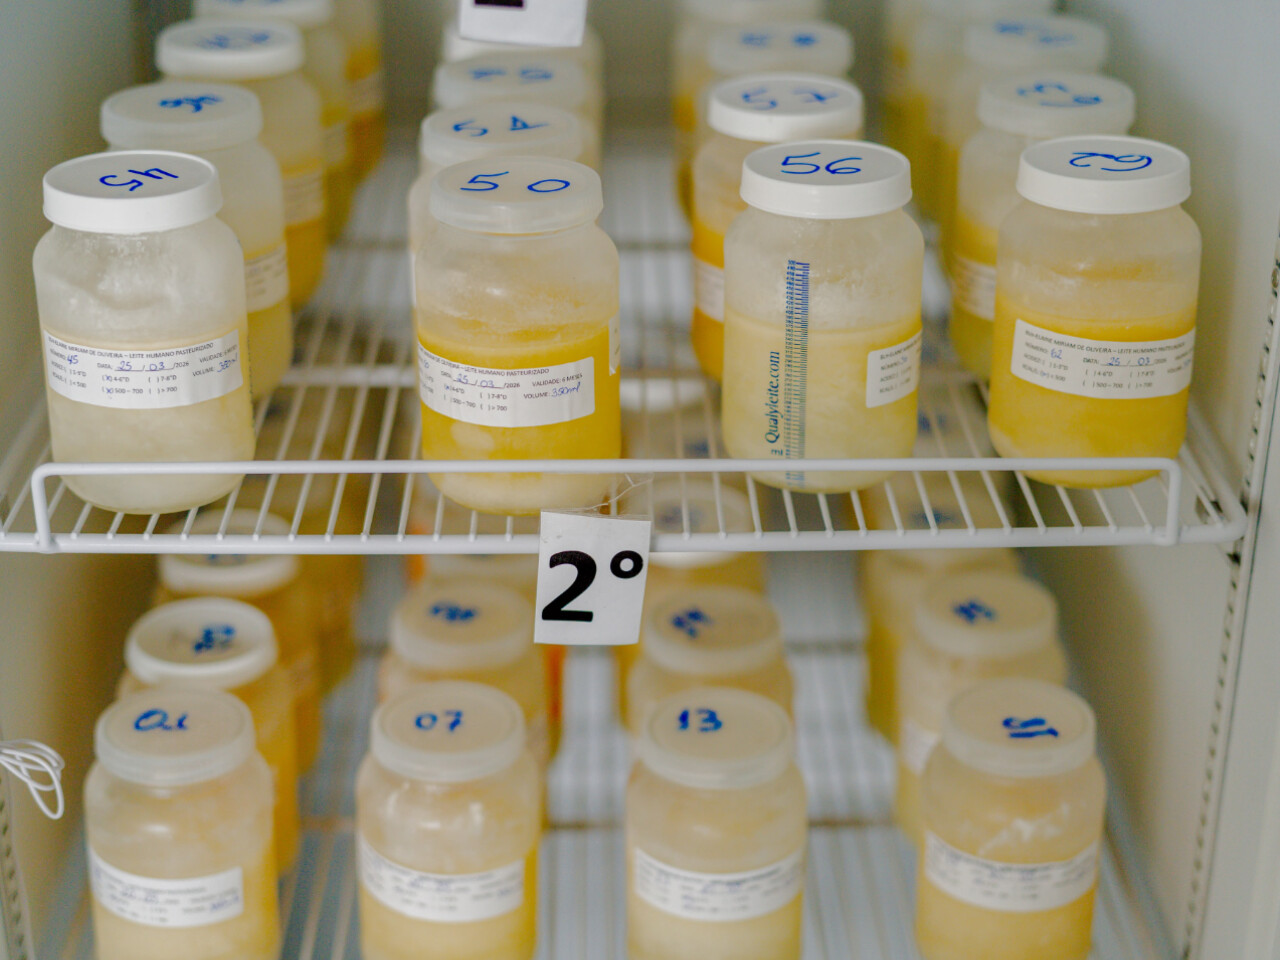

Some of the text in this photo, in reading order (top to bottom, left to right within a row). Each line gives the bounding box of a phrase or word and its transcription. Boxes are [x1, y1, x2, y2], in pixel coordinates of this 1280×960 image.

[780, 151, 862, 175] 56
[145, 351, 175, 359] HUMANO
[175, 342, 215, 356] PASTEURIZADO
[66, 353, 80, 366] 45
[116, 359, 133, 371] 25
[478, 369, 505, 377] HUMANO
[506, 368, 550, 377] PASTEURIZADO
[531, 377, 561, 388] VALIDADE:
[523, 391, 551, 400] VOLUME:
[415, 709, 464, 732] 07
[677, 707, 723, 732] 13
